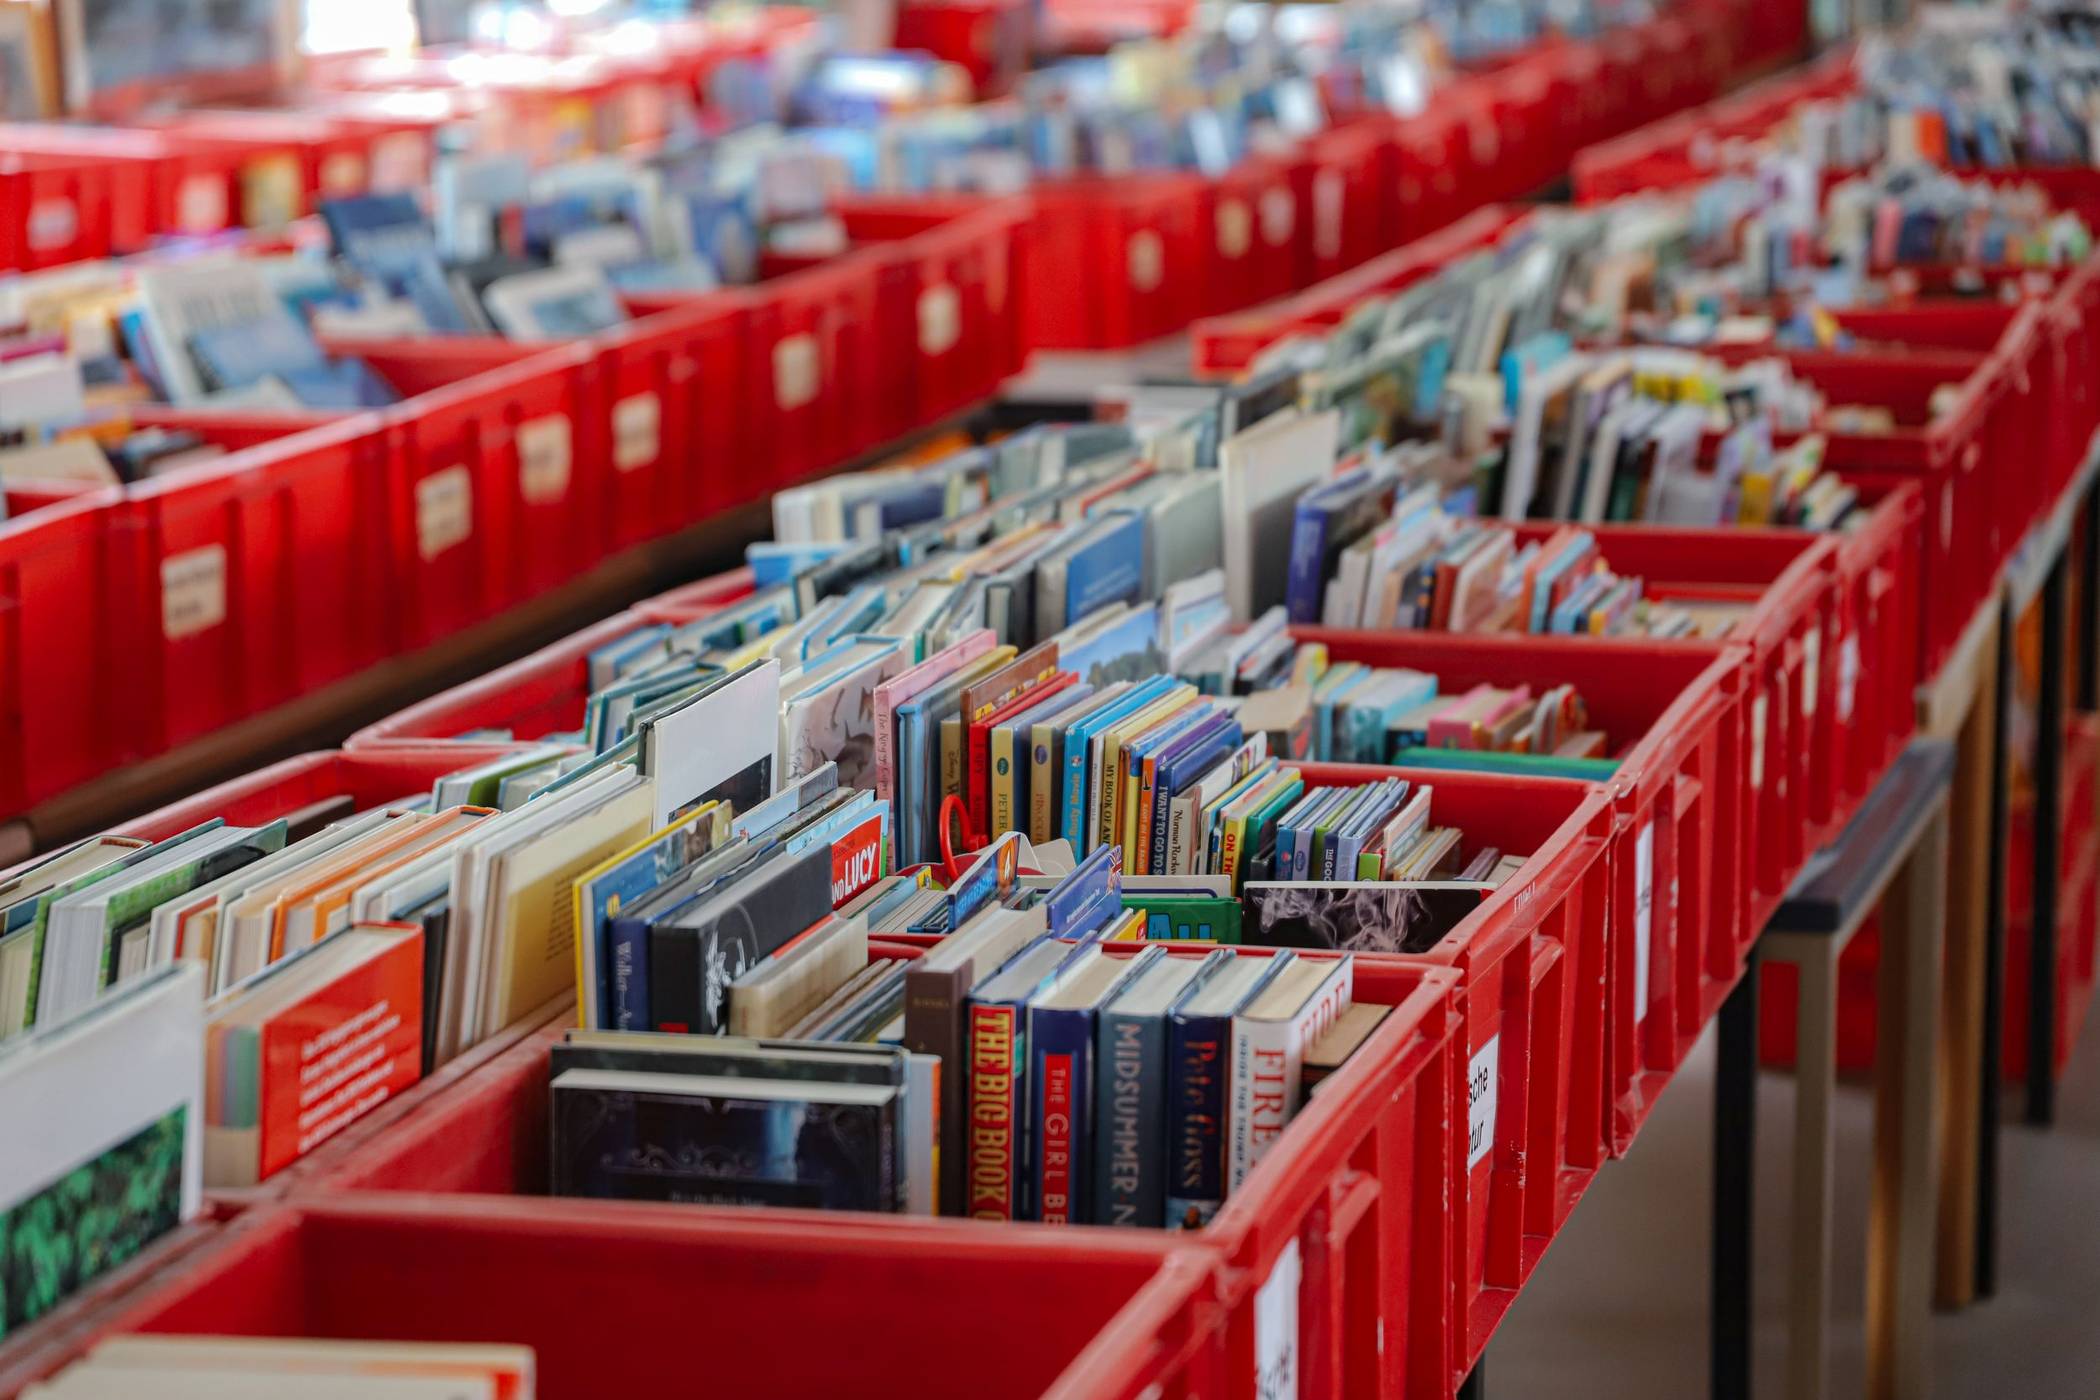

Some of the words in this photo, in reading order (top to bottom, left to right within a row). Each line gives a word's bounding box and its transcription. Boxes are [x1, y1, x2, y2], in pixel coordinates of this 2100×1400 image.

[1106, 764, 1114, 779] MY
[999, 794, 1008, 829] PETER
[1104, 781, 1114, 810] BOOK
[1157, 791, 1168, 821] WANT
[1104, 811, 1112, 826] OF
[1156, 821, 1166, 835] TO
[1172, 810, 1183, 847] Norman
[1155, 837, 1165, 853] GO
[1226, 833, 1236, 853] ON
[844, 842, 877, 894] LUCY
[1154, 854, 1164, 868] TO
[975, 1013, 1010, 1068] THE
[974, 1073, 1010, 1122] BIG
[1050, 1069, 1066, 1104] THE
[1253, 1048, 1285, 1145] FIRE
[1112, 1024, 1142, 1193] MIDSUMMER
[1045, 1113, 1069, 1180] GIRL
[973, 1128, 1008, 1204] BOOK
